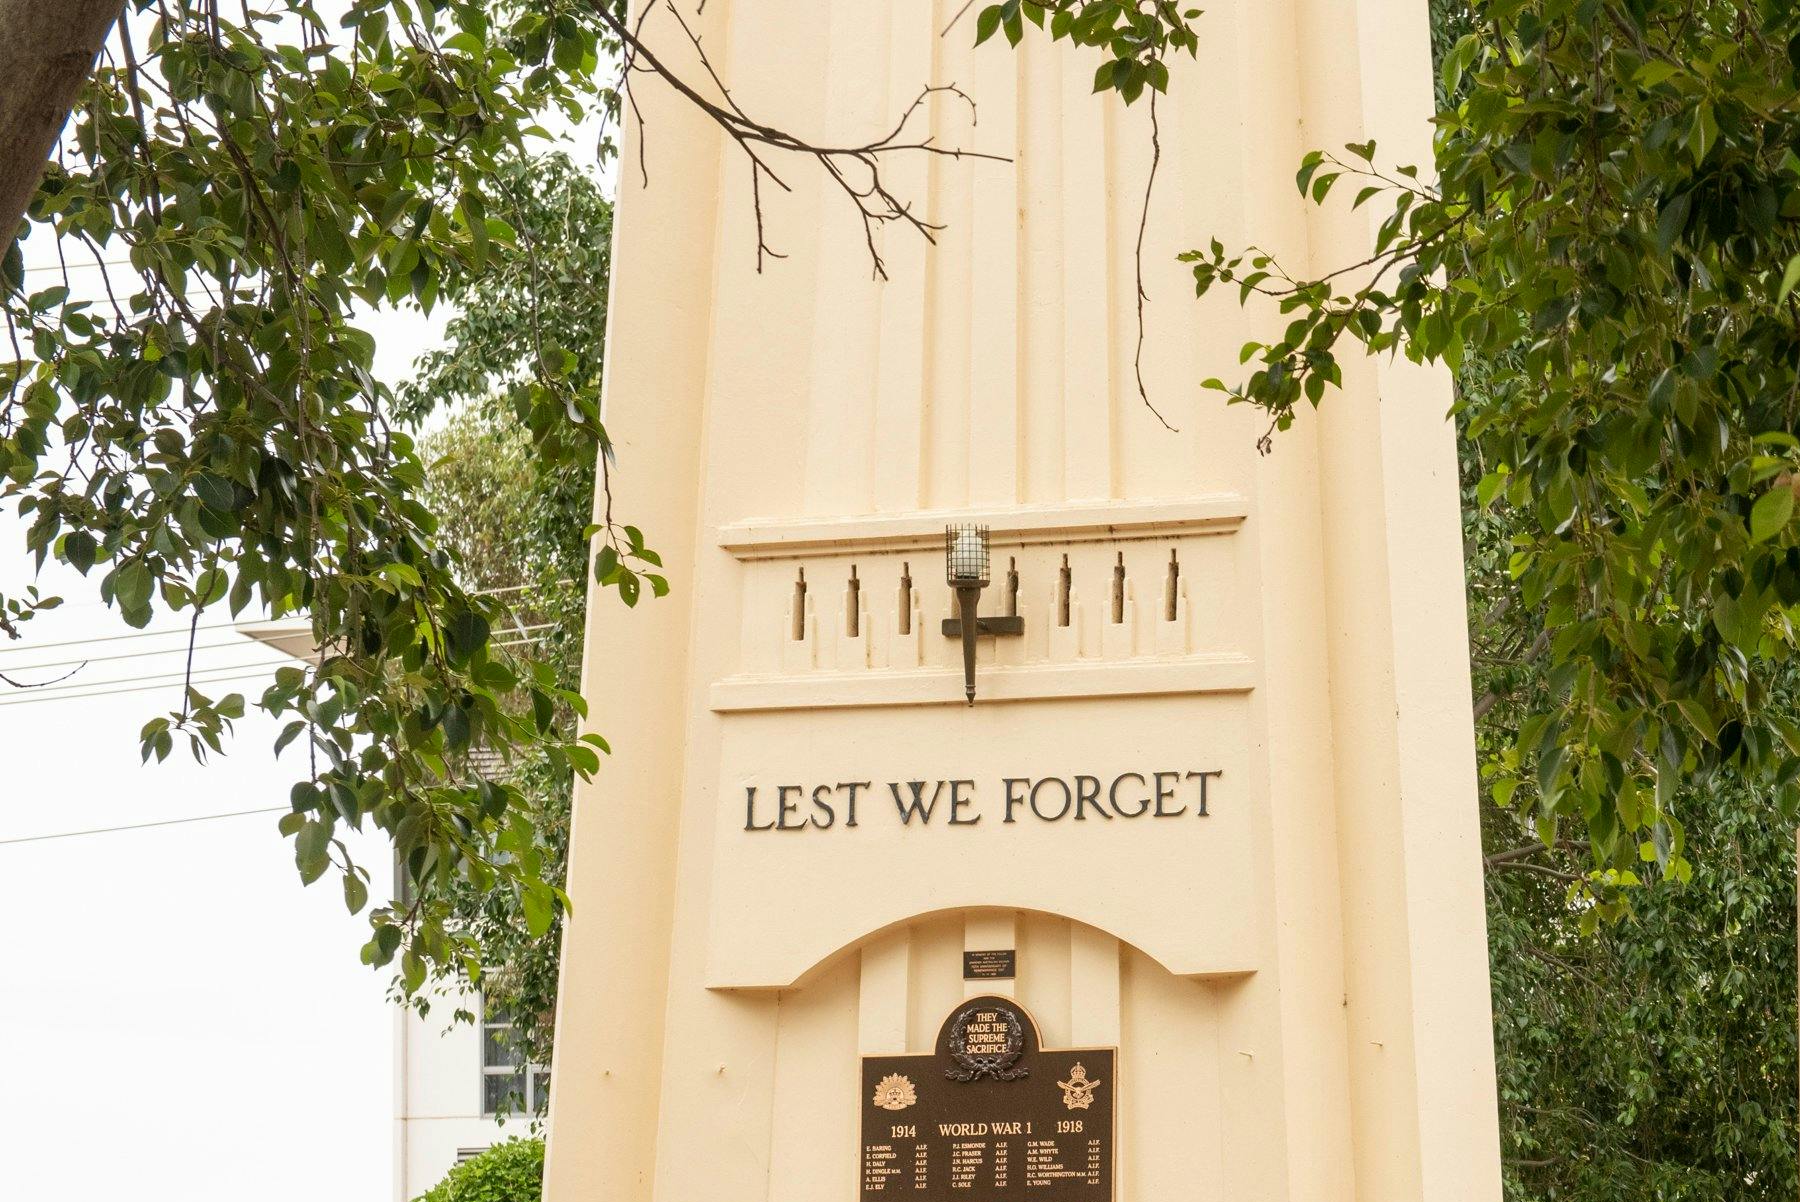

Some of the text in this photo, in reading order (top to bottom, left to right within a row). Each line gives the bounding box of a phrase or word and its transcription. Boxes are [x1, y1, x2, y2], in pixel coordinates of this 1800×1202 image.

[744, 770, 1223, 831] LEST WE FORGET
[976, 1013, 998, 1022] THEY
[967, 1023, 1008, 1033] MADE THE
[969, 1034, 1005, 1043] SUPREME
[891, 1121, 1083, 1138] 1914 WORLD WAR 1 1918
